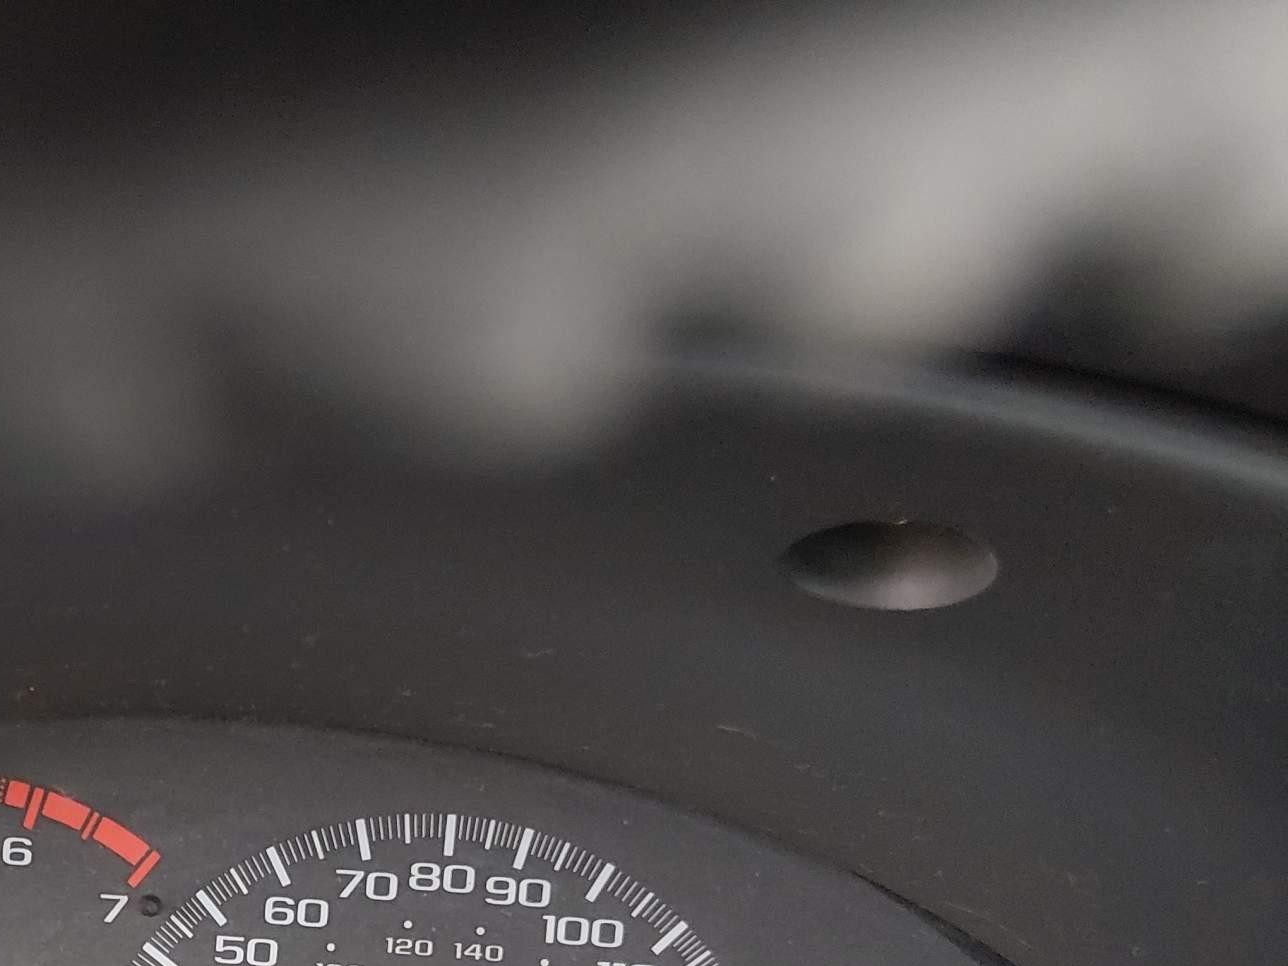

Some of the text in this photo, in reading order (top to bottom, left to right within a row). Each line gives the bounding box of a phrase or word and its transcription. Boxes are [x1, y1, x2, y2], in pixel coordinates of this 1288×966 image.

[3, 838, 32, 865] 6
[336, 870, 398, 900] 70
[409, 863, 475, 893] 80
[486, 877, 551, 907] 90
[101, 894, 128, 922] 7
[265, 897, 328, 927] 60
[386, 938, 432, 955] 120
[543, 916, 623, 947] 100
[215, 936, 278, 966] 50
[455, 943, 503, 961] 140
